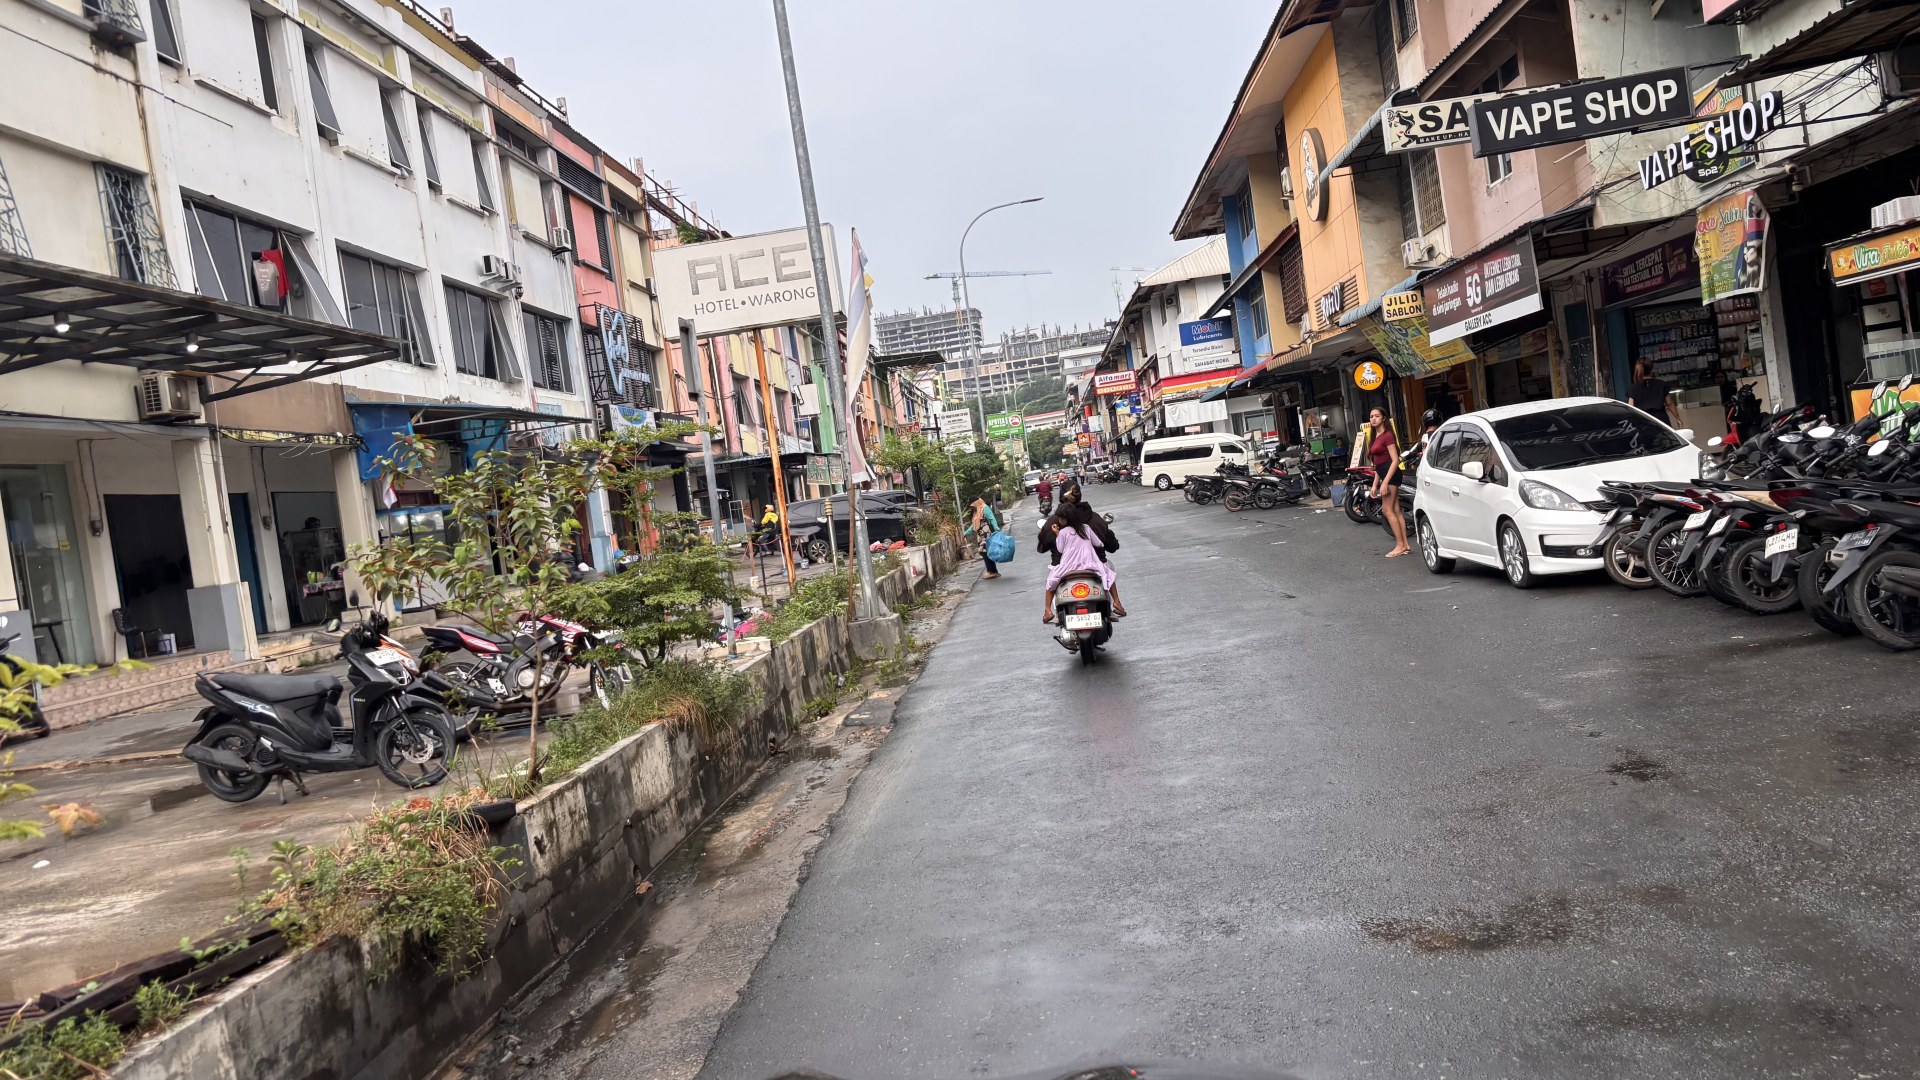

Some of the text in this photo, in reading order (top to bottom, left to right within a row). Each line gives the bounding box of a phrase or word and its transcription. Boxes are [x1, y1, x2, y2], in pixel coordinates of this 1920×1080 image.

[1486, 96, 1576, 141] VAPE
[1584, 79, 1678, 125] SHOP
[1420, 135, 1440, 143] MAKE
[1637, 91, 1775, 190] VAPE SHOP
[1854, 245, 1880, 271] Vira
[687, 242, 812, 295] ACE
[1466, 273, 1482, 307] 5G
[694, 286, 816, 315] HOTEL WARONG
[1387, 294, 1418, 307] JILID
[1386, 304, 1422, 318] SABLON
[1192, 321, 1223, 335] Mobil
[1465, 313, 1493, 331] GALLERY ACC
[1193, 332, 1223, 341] Lubricants
[1098, 373, 1132, 382] Alfamart
